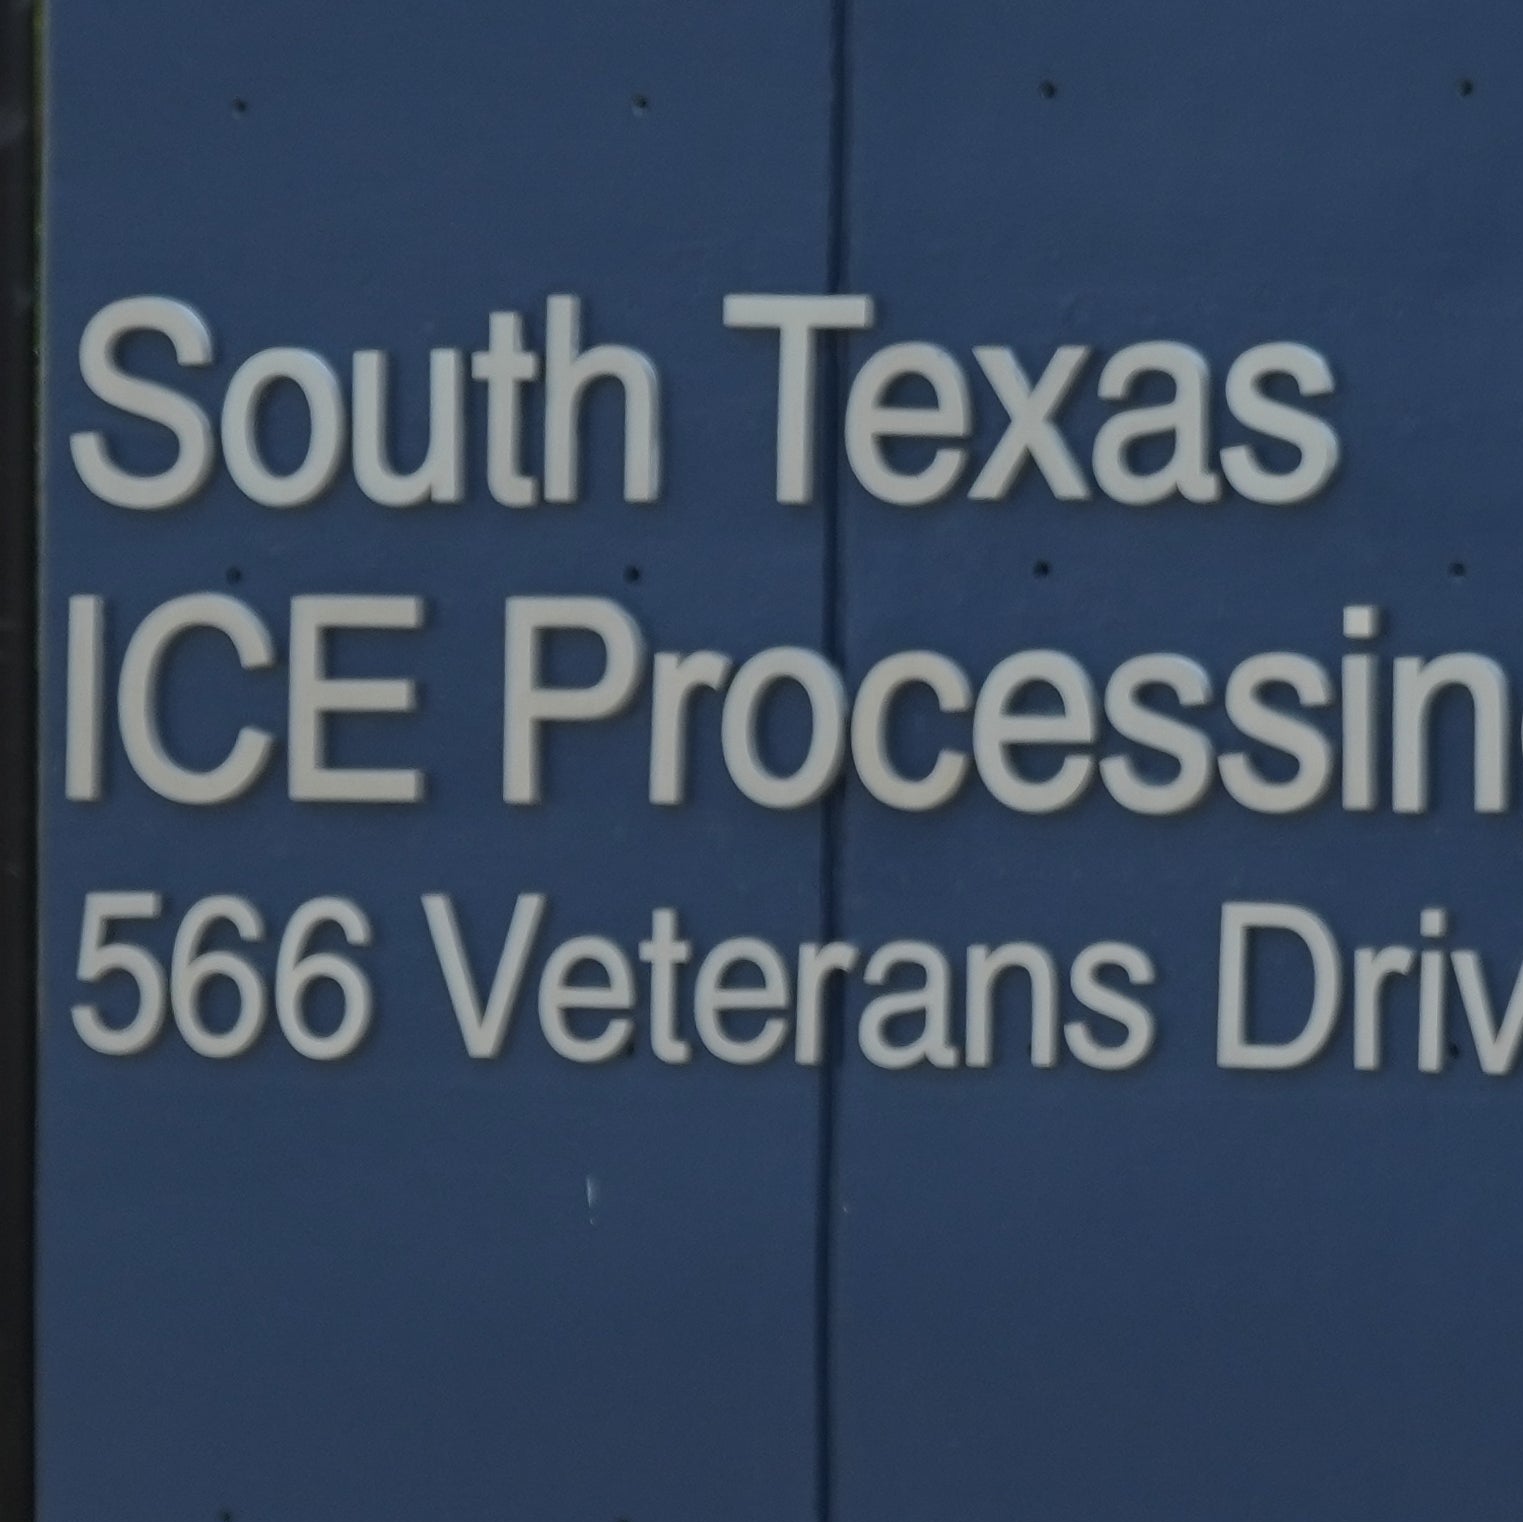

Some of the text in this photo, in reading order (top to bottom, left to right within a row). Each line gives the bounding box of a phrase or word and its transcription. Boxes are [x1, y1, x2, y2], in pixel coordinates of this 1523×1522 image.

[70, 293, 1341, 510] South Texas
[65, 592, 424, 804] ICE
[70, 891, 372, 1060] 566
[421, 893, 1155, 1070] Veterans
